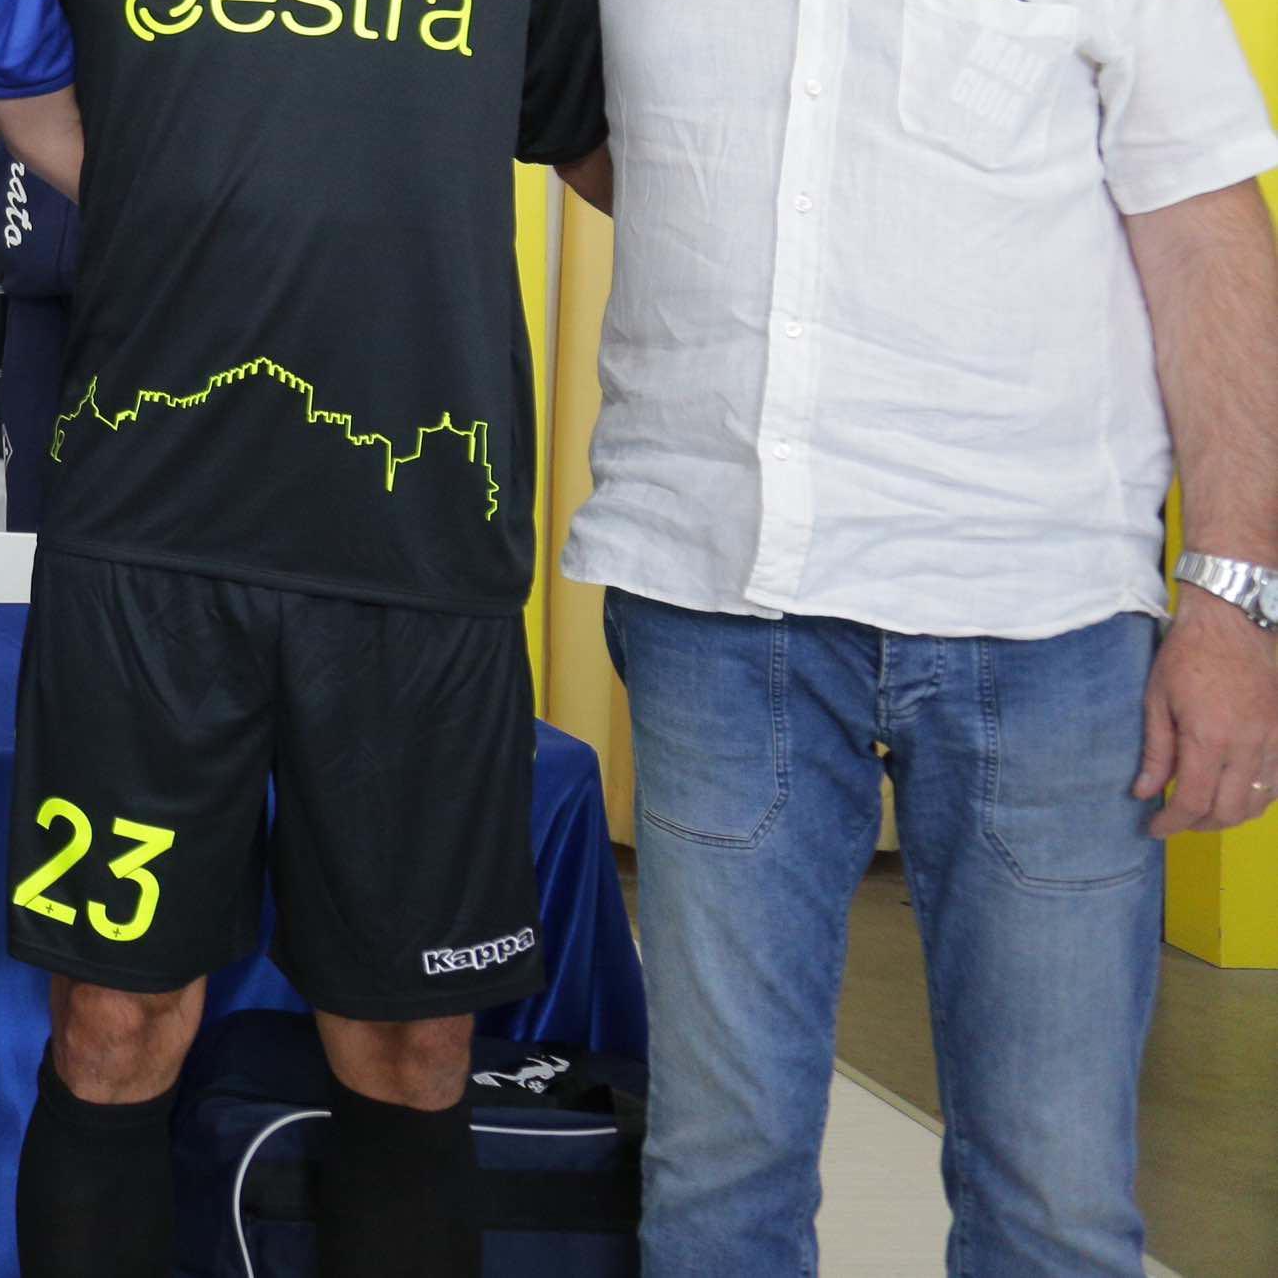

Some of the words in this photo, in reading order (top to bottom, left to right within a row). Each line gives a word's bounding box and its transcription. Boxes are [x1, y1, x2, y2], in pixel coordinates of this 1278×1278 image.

[3, 162, 33, 249] rato
[12, 797, 176, 942] 23
[422, 927, 535, 975] Kappa
